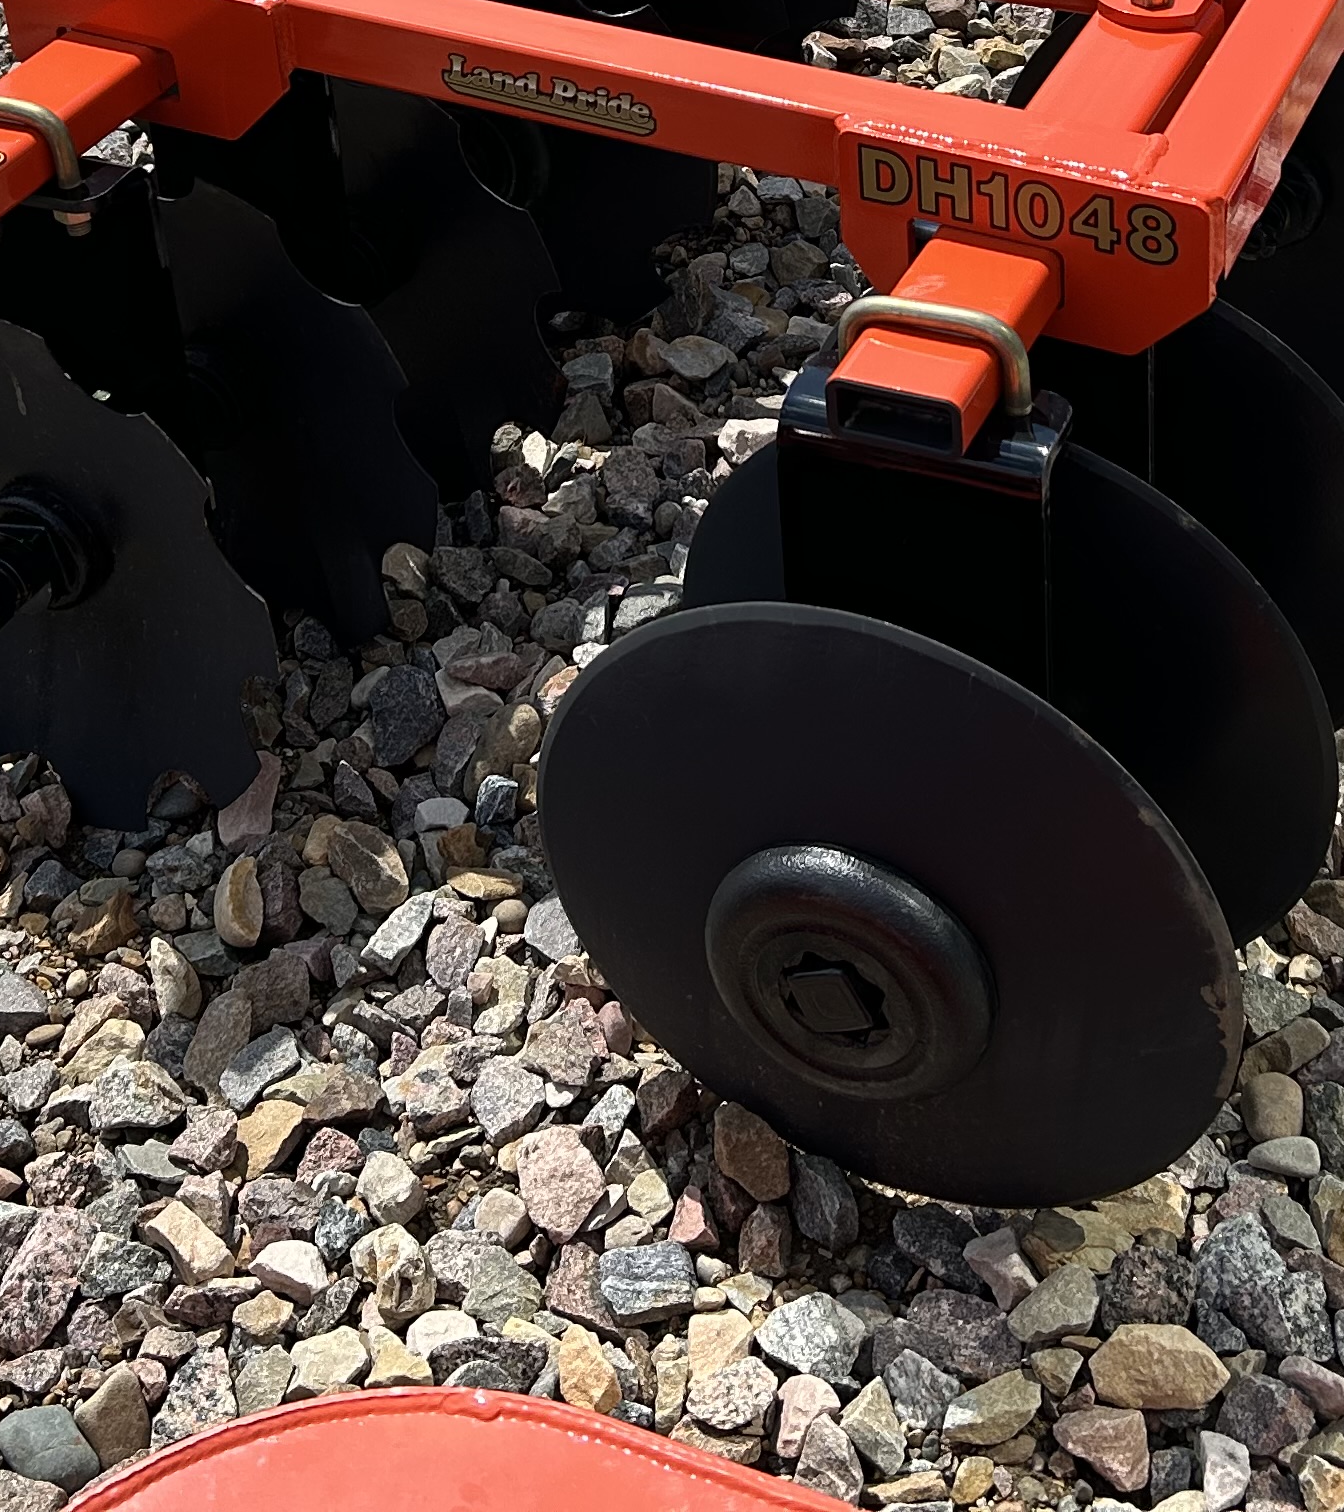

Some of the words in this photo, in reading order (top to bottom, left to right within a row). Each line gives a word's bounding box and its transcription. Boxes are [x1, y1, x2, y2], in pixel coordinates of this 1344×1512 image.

[448, 53, 540, 100] Land
[551, 77, 651, 125] Pride
[858, 143, 1179, 266] DH1048
